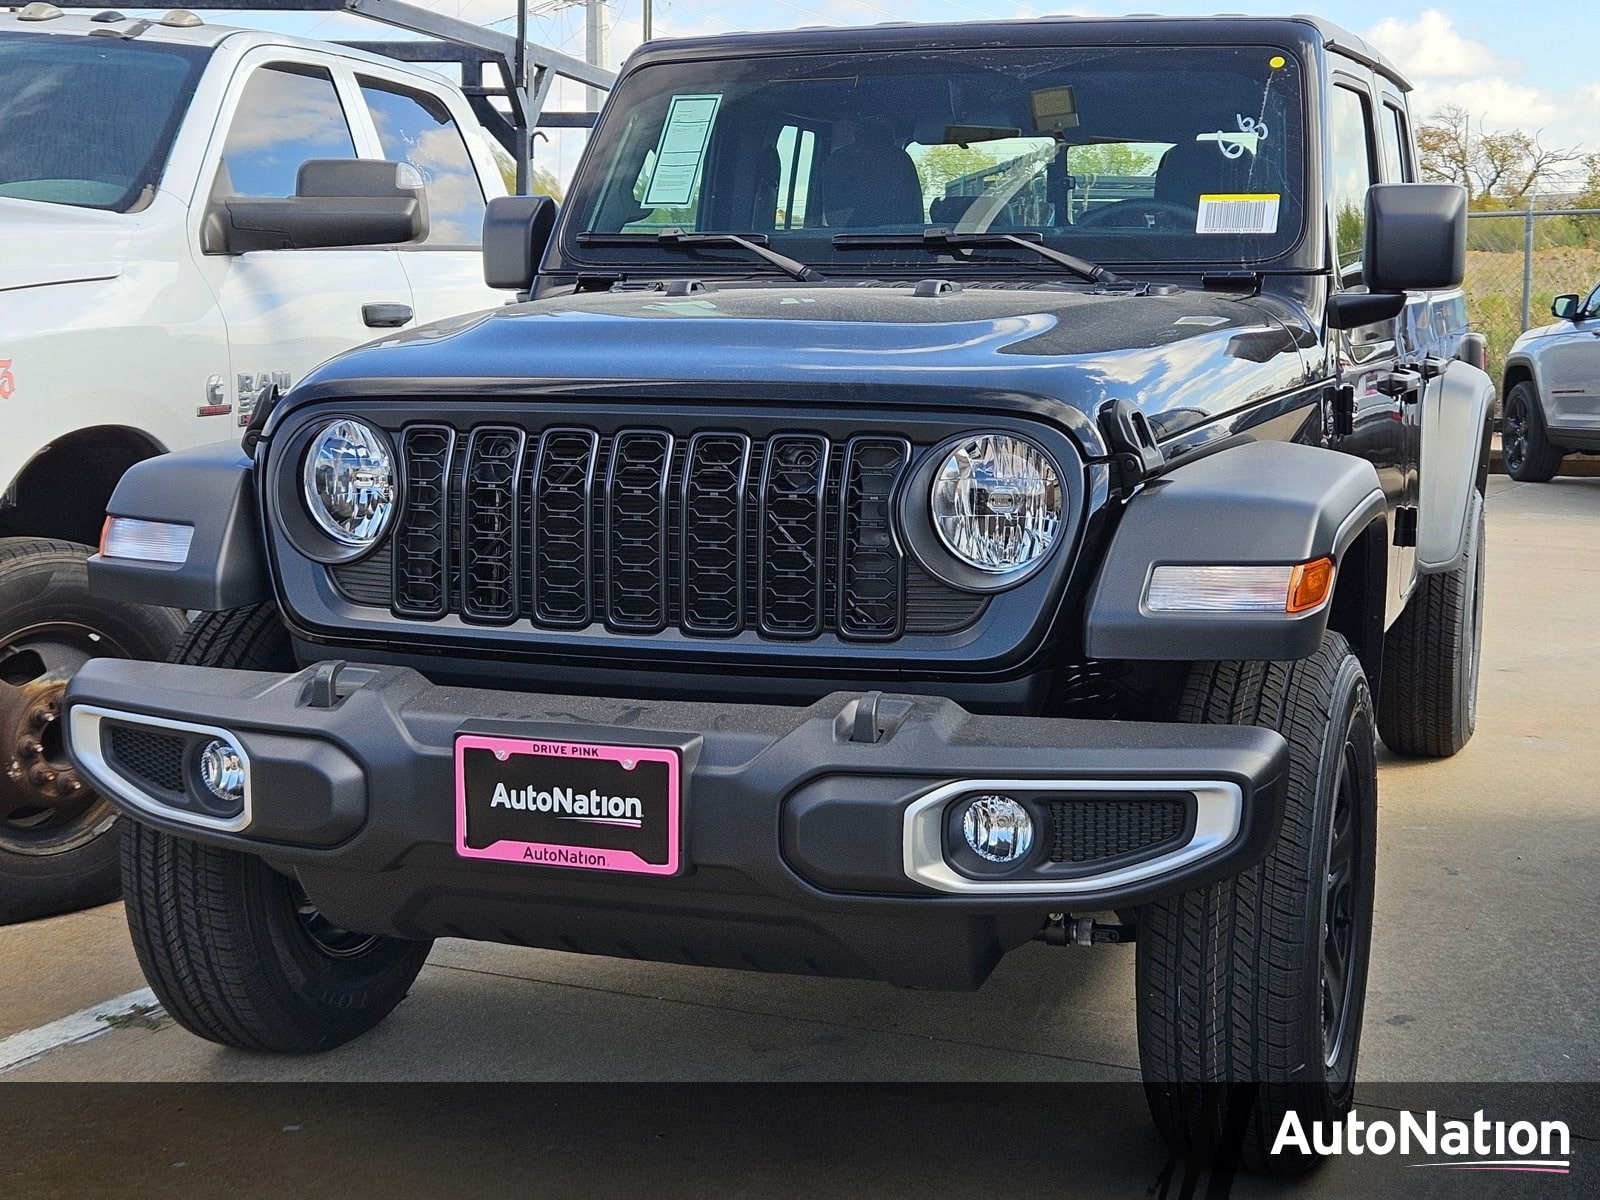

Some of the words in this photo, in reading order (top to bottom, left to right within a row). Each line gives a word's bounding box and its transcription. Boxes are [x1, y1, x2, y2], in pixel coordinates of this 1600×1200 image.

[532, 744, 568, 755] DRIVE
[571, 746, 599, 757] PINK
[490, 782, 643, 818] AutoNation
[523, 846, 607, 866] AutoNation
